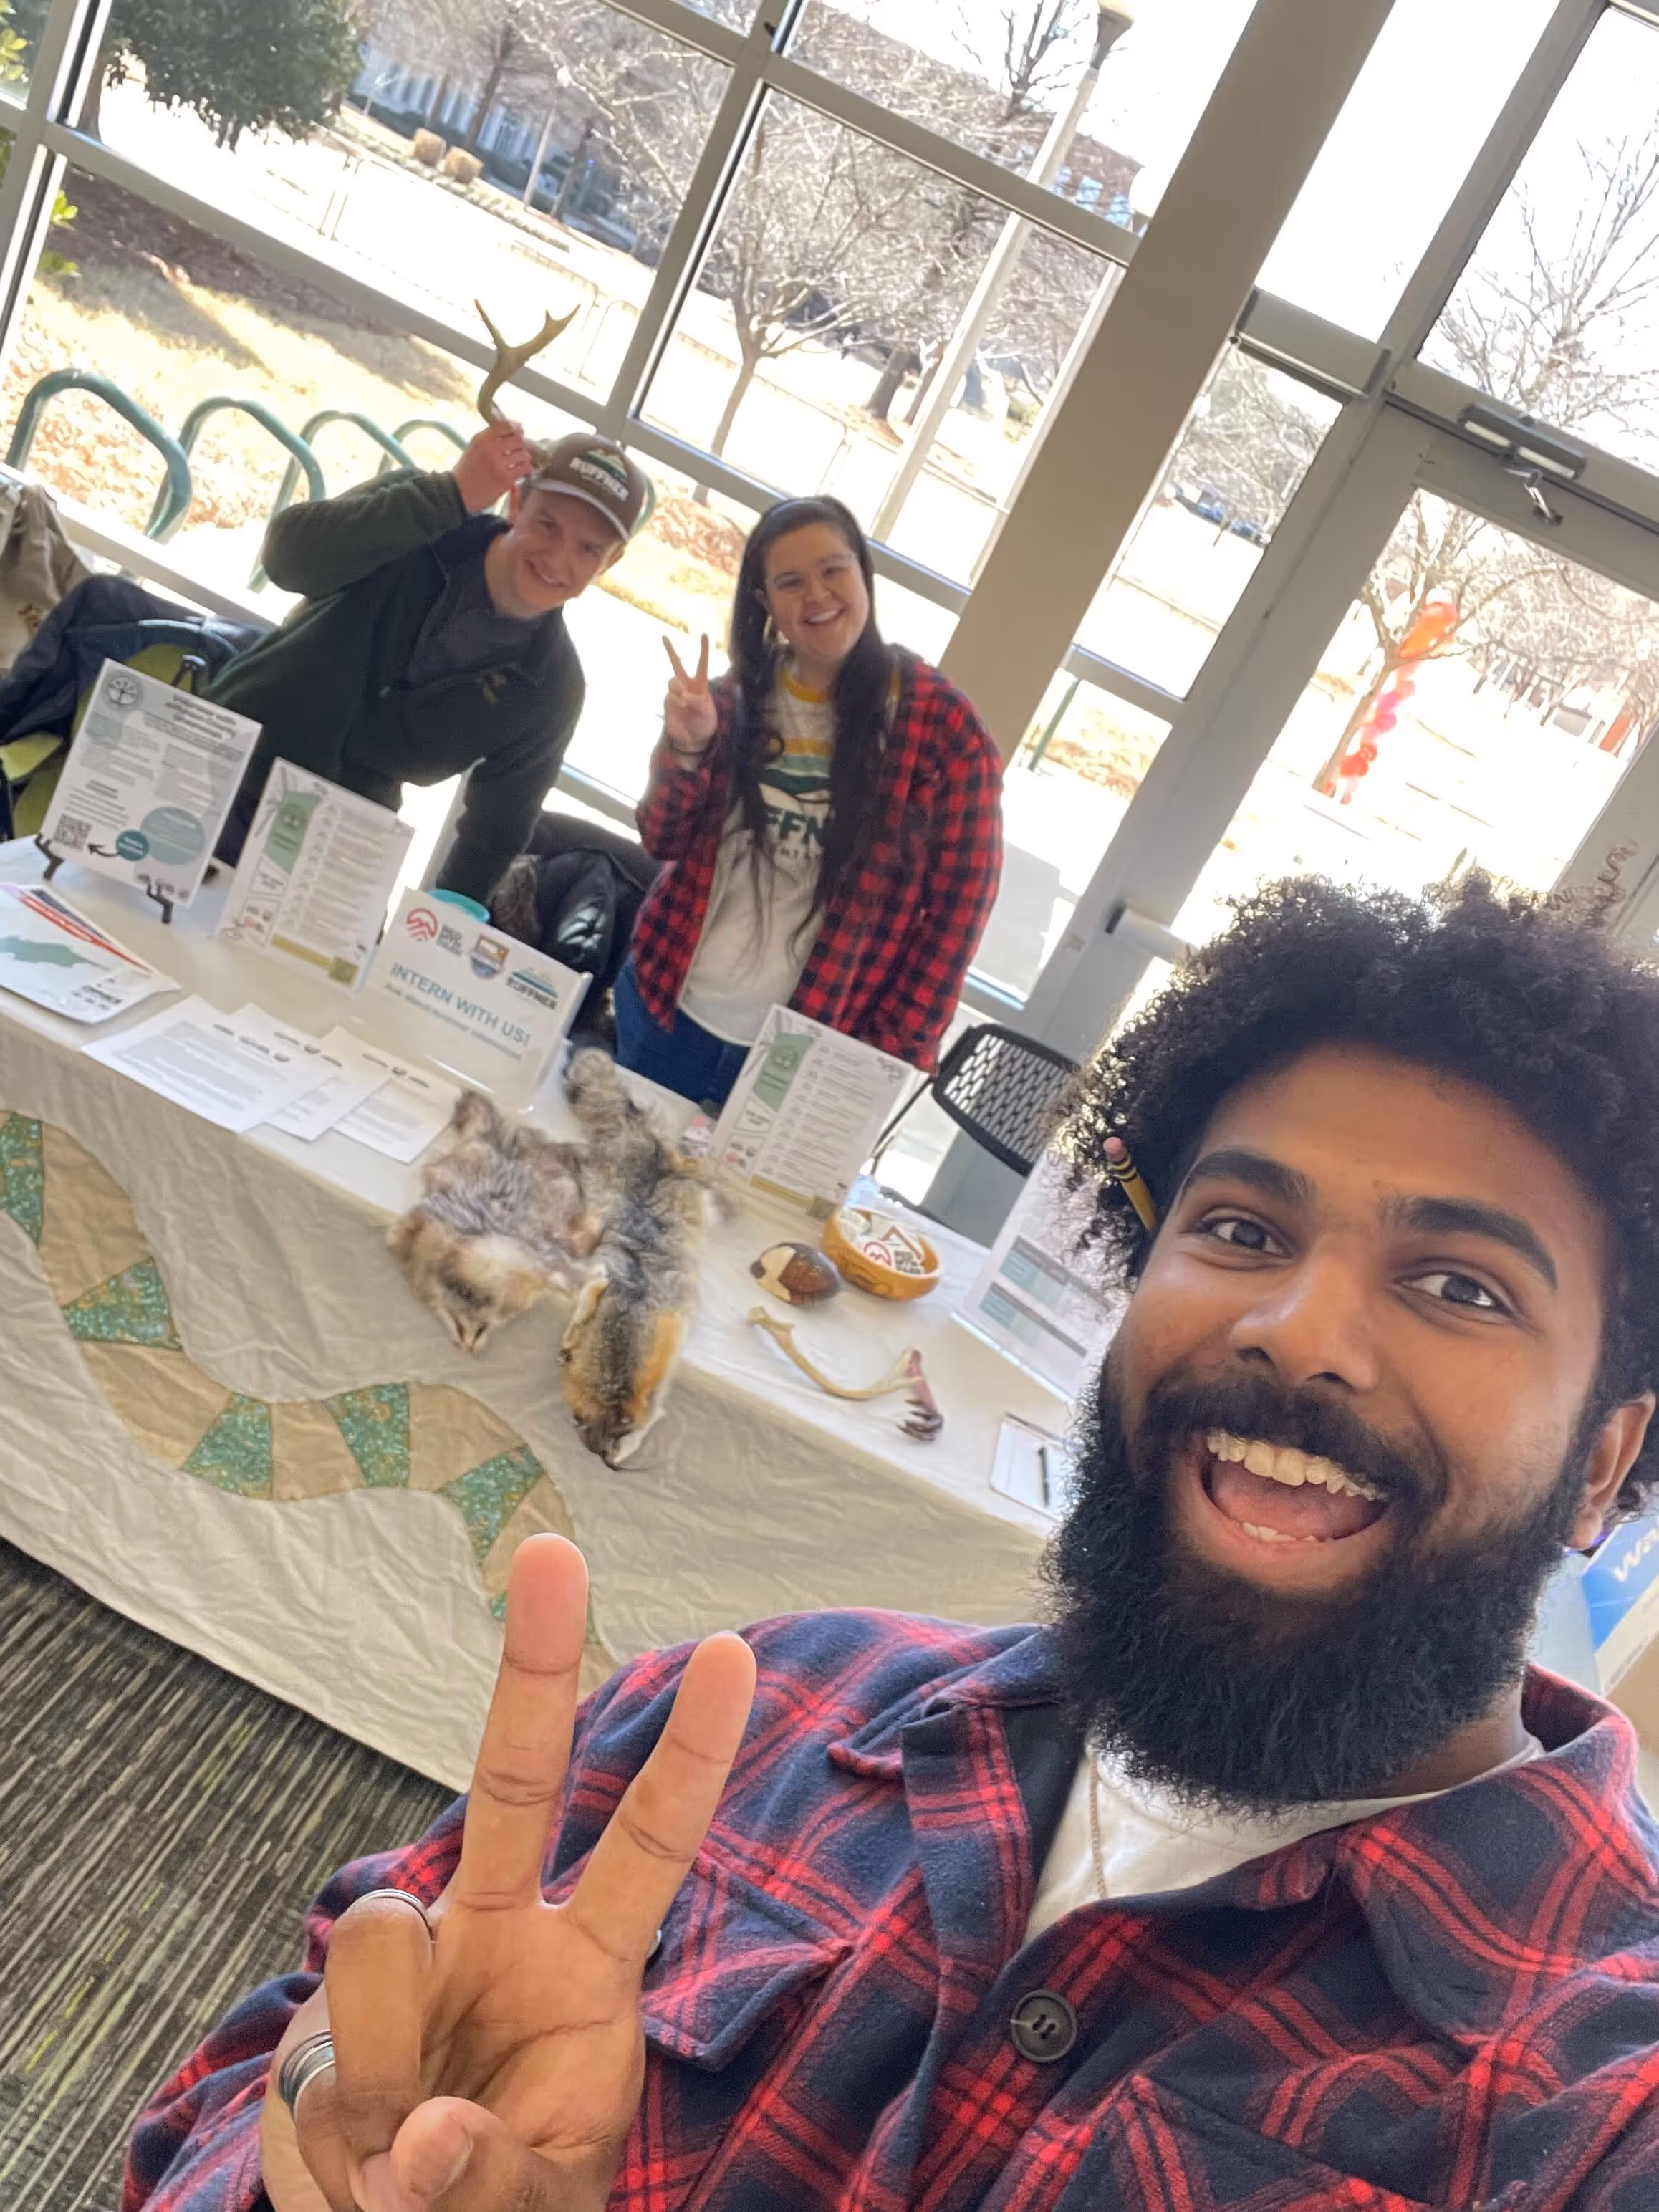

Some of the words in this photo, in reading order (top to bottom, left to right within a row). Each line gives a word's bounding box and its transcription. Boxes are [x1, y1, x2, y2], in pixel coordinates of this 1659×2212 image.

[390, 962, 453, 1004] INTERN
[456, 996, 499, 1029] WITH
[501, 1020, 531, 1047] US!
